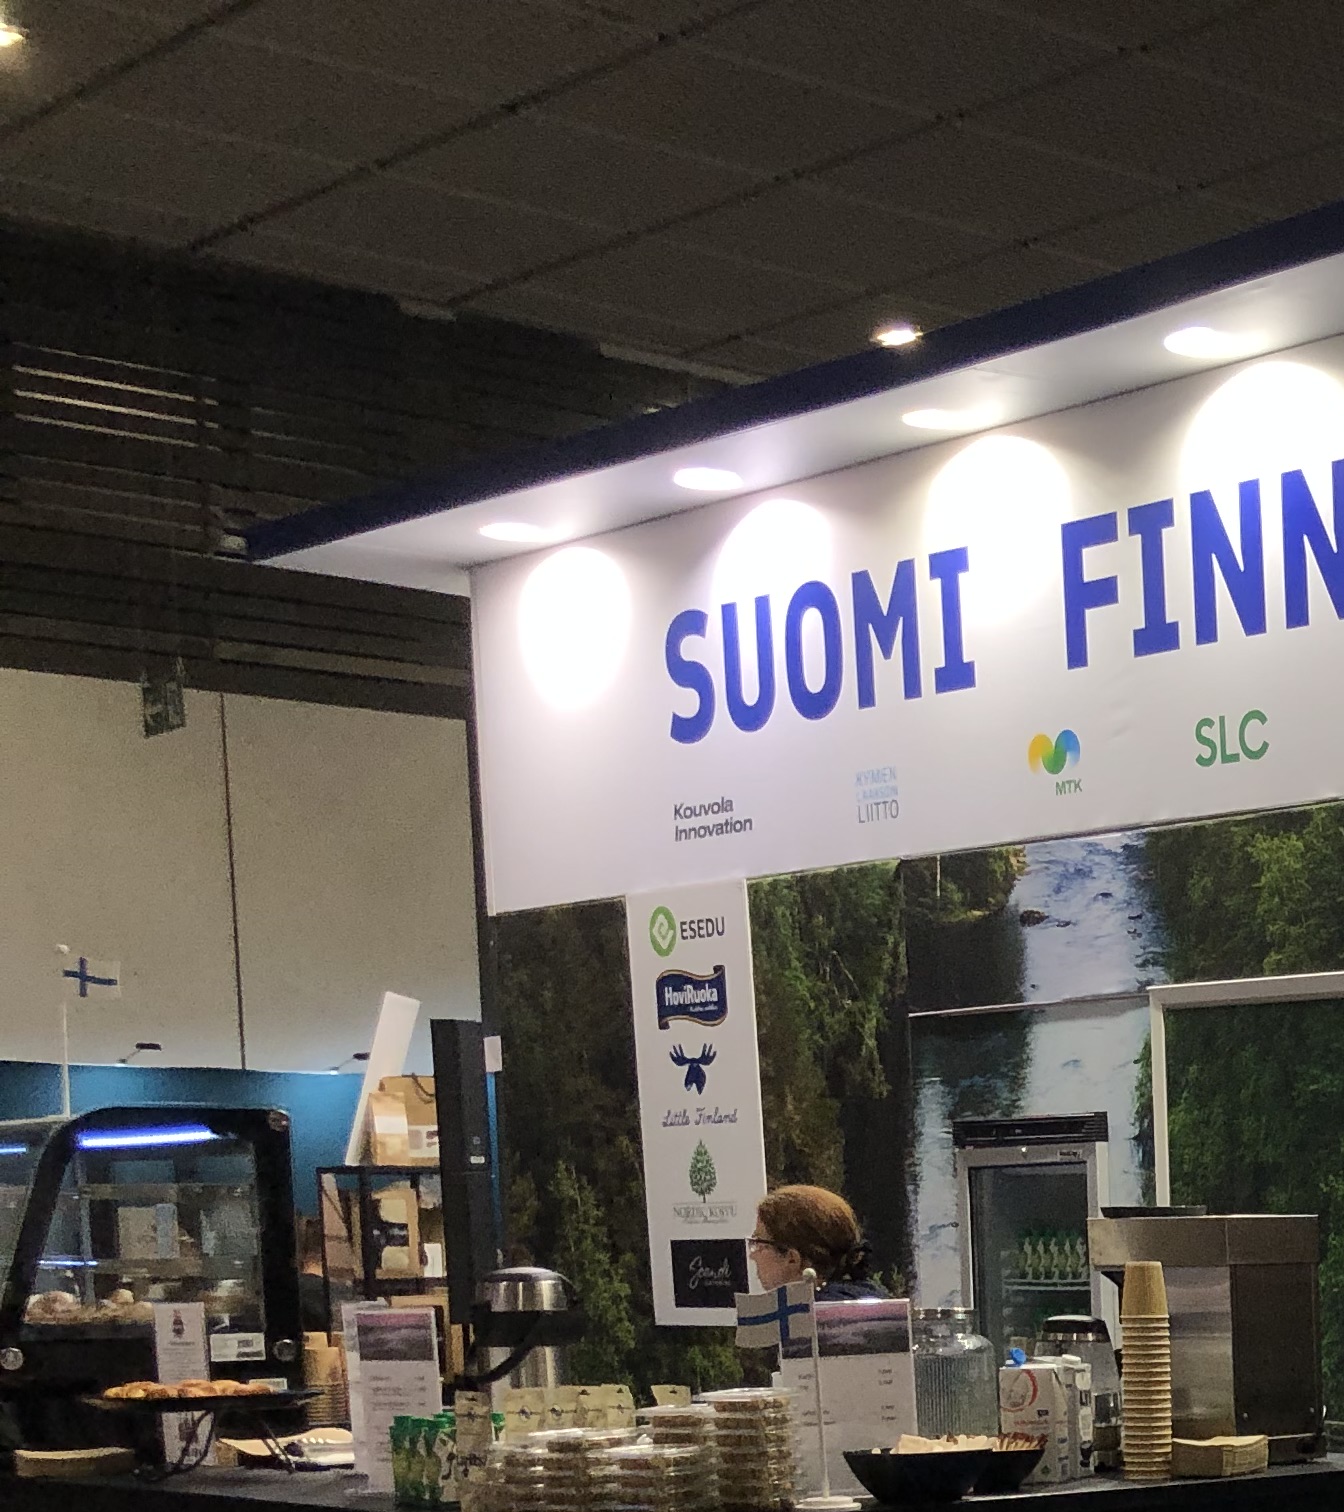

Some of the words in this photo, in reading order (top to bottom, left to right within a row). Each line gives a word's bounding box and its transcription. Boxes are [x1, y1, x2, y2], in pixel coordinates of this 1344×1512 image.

[665, 546, 976, 744] SUOMI
[1195, 709, 1270, 768] SLC
[1055, 778, 1083, 796] MTK
[673, 797, 734, 821] Kouvola
[857, 798, 899, 824] LIITTO
[674, 816, 753, 842] Innovation
[679, 916, 725, 941] ESEDU
[665, 984, 718, 1006] HoviRuoka
[662, 1108, 690, 1128] Little
[695, 1107, 738, 1126] Finland
